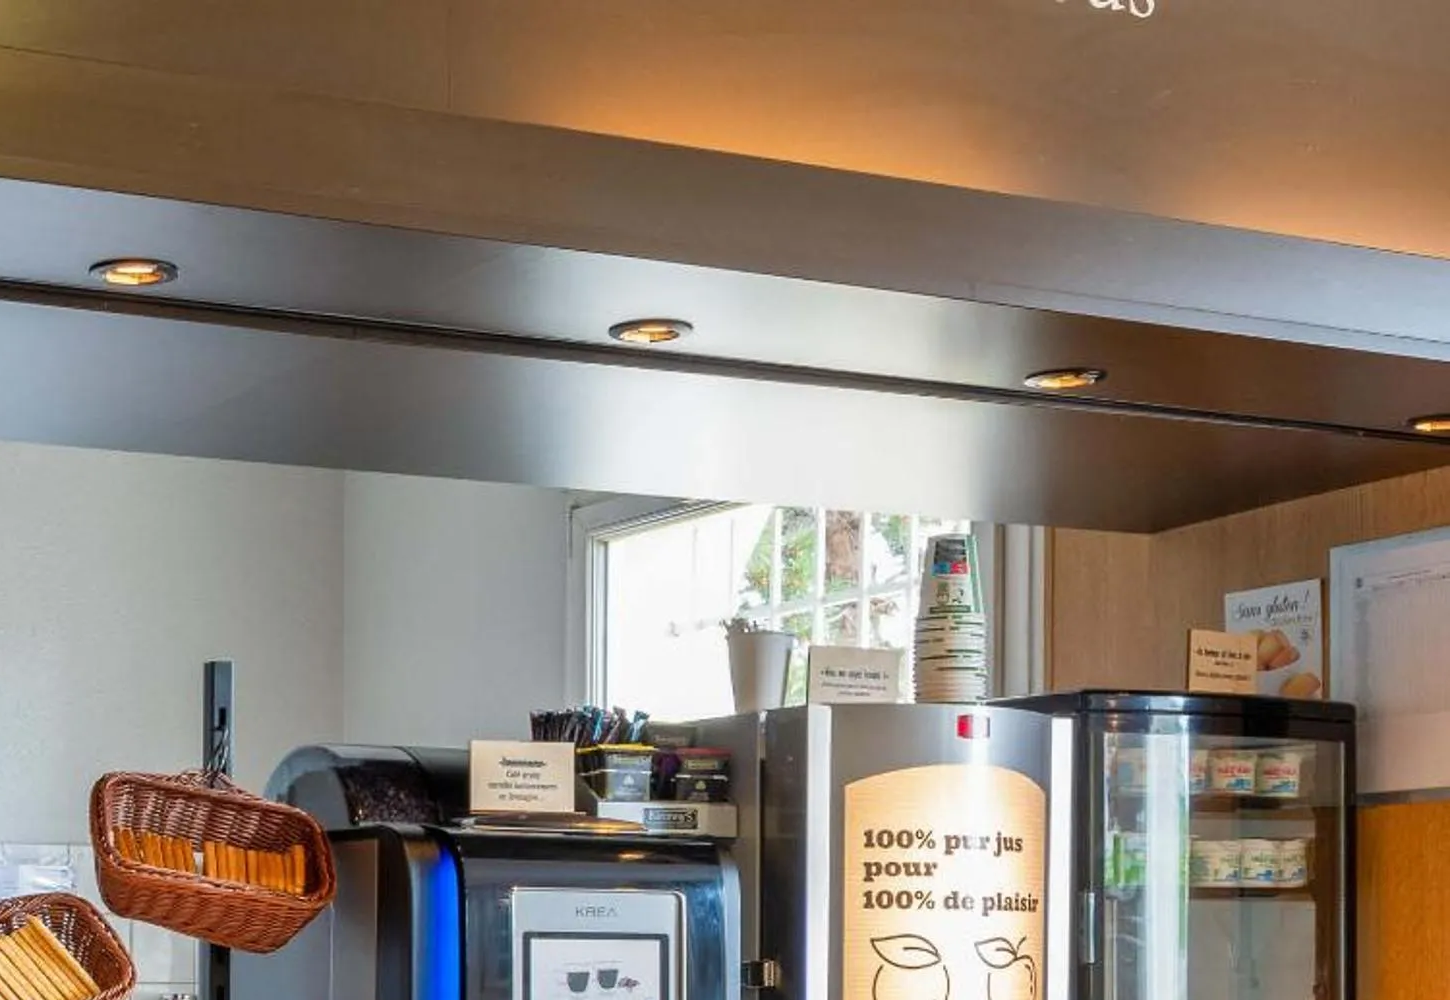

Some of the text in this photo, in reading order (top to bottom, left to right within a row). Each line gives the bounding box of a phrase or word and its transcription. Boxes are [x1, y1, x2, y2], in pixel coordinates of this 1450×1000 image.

[863, 829, 937, 849] 100%
[994, 831, 1023, 857] jus
[863, 861, 938, 882] pour
[575, 906, 618, 917] KREA
[863, 890, 1039, 917] 100% de plaisir
